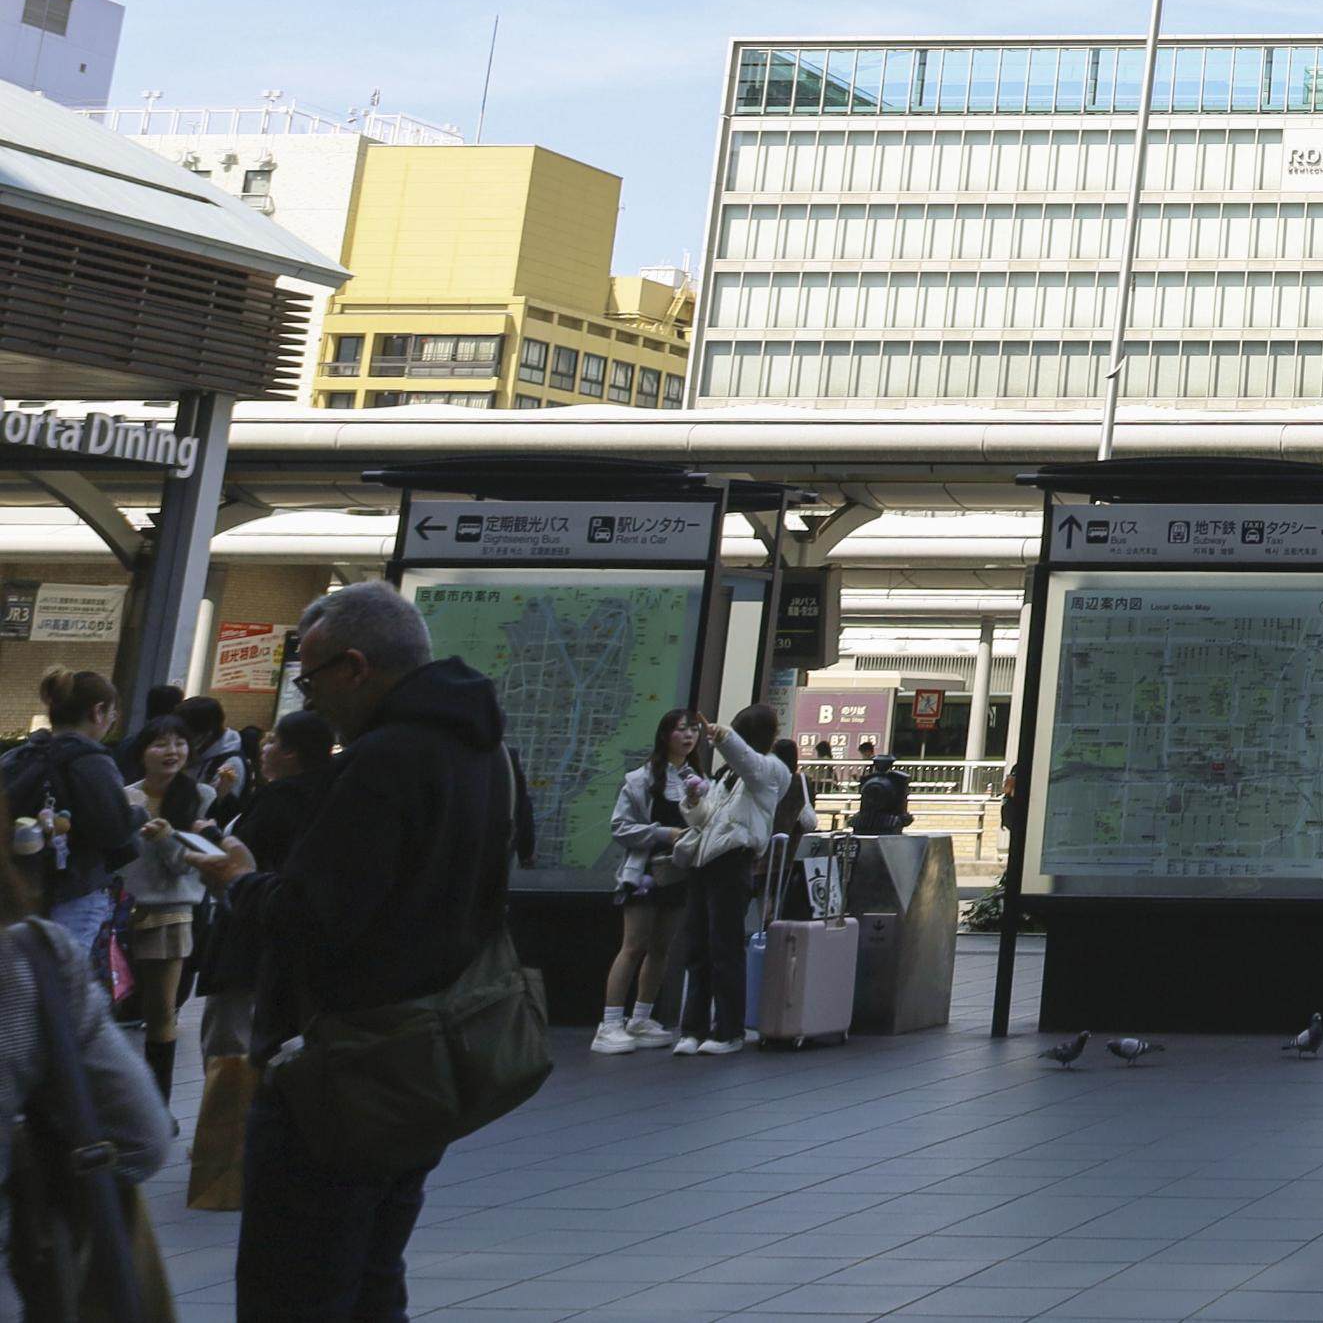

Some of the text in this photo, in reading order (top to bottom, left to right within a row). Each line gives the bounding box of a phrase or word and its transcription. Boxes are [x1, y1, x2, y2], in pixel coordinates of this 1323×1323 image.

[0, 396, 199, 478] orta Dining
[485, 516, 569, 533] 定期観光バス
[617, 516, 700, 533] 駅レンタカー
[1112, 520, 1138, 535] バス
[1194, 520, 1236, 535] 地下鉄
[1266, 521, 1317, 535] タクシー
[483, 534, 560, 546] Sightseeing Bus
[615, 535, 638, 544] Rent
[650, 535, 668, 545] Car
[1110, 536, 1127, 545] Bus
[1193, 537, 1226, 547] Subway
[1266, 537, 1284, 545] Taxi
[419, 589, 500, 603] 京都市内案内
[1195, 603, 1211, 611] Map
[5, 607, 30, 622] JR3
[818, 704, 833, 725] B
[840, 705, 867, 717] のりば
[800, 734, 817, 746] B1
[830, 734, 847, 746] B2
